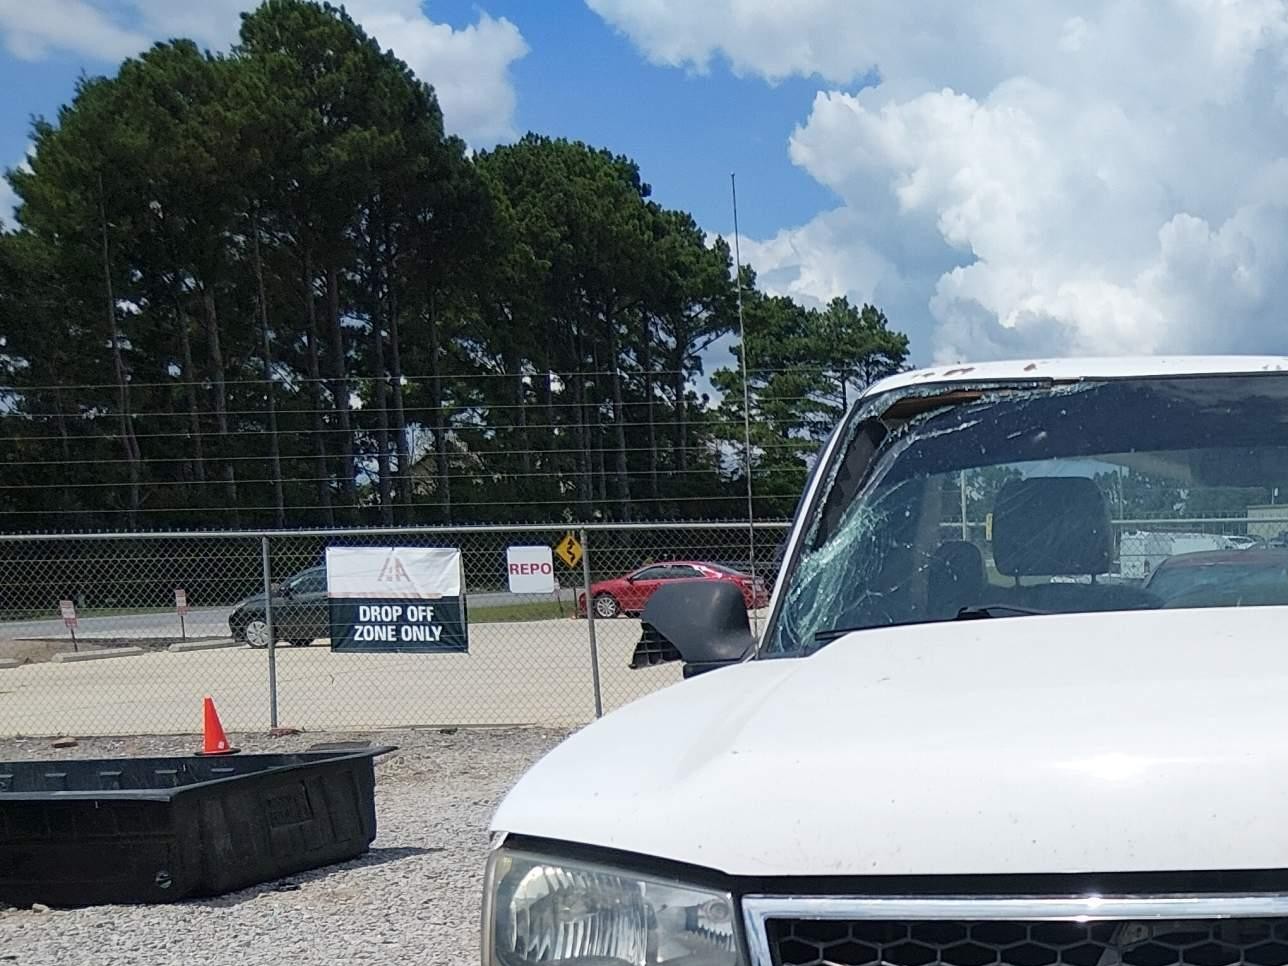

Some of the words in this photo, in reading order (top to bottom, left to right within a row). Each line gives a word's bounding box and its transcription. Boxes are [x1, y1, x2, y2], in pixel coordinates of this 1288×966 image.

[509, 562, 552, 576] REPO
[359, 605, 403, 622] DROP
[406, 605, 434, 622] OFF
[353, 625, 398, 641] ZONE
[400, 625, 443, 641] ONLY
